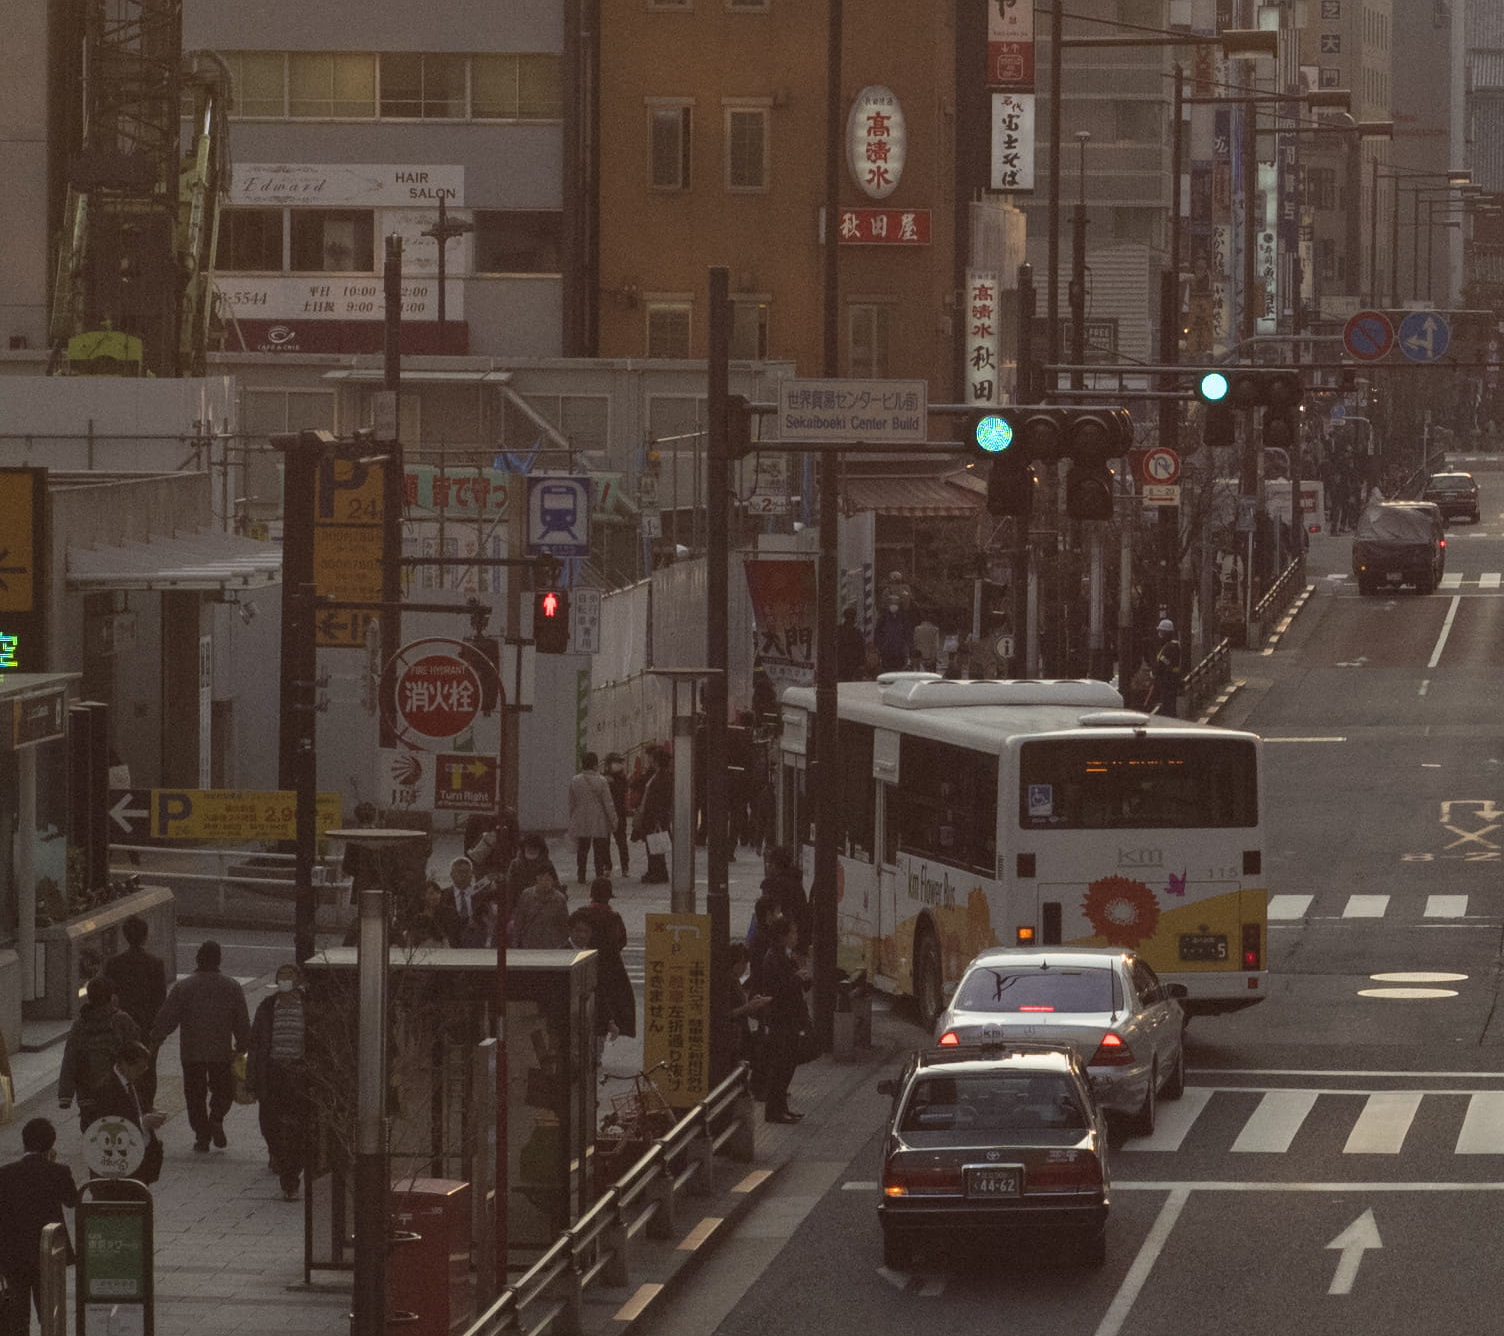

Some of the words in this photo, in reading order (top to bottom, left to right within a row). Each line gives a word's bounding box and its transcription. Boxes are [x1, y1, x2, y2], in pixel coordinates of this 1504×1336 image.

[866, 111, 893, 190] 高清水
[243, 177, 327, 193] Edward
[395, 173, 429, 183] HAIR
[409, 188, 456, 200] SALON
[840, 212, 918, 240] 秋田屋
[343, 286, 376, 297] 10:00
[347, 301, 373, 312] 9:00
[788, 390, 918, 409] 世界貿易センタービル前
[851, 414, 887, 430] Center
[405, 680, 474, 712] 消火栓
[440, 790, 462, 802] Turn
[464, 790, 489, 803] Right
[159, 793, 192, 835] P
[1118, 848, 1163, 863] km
